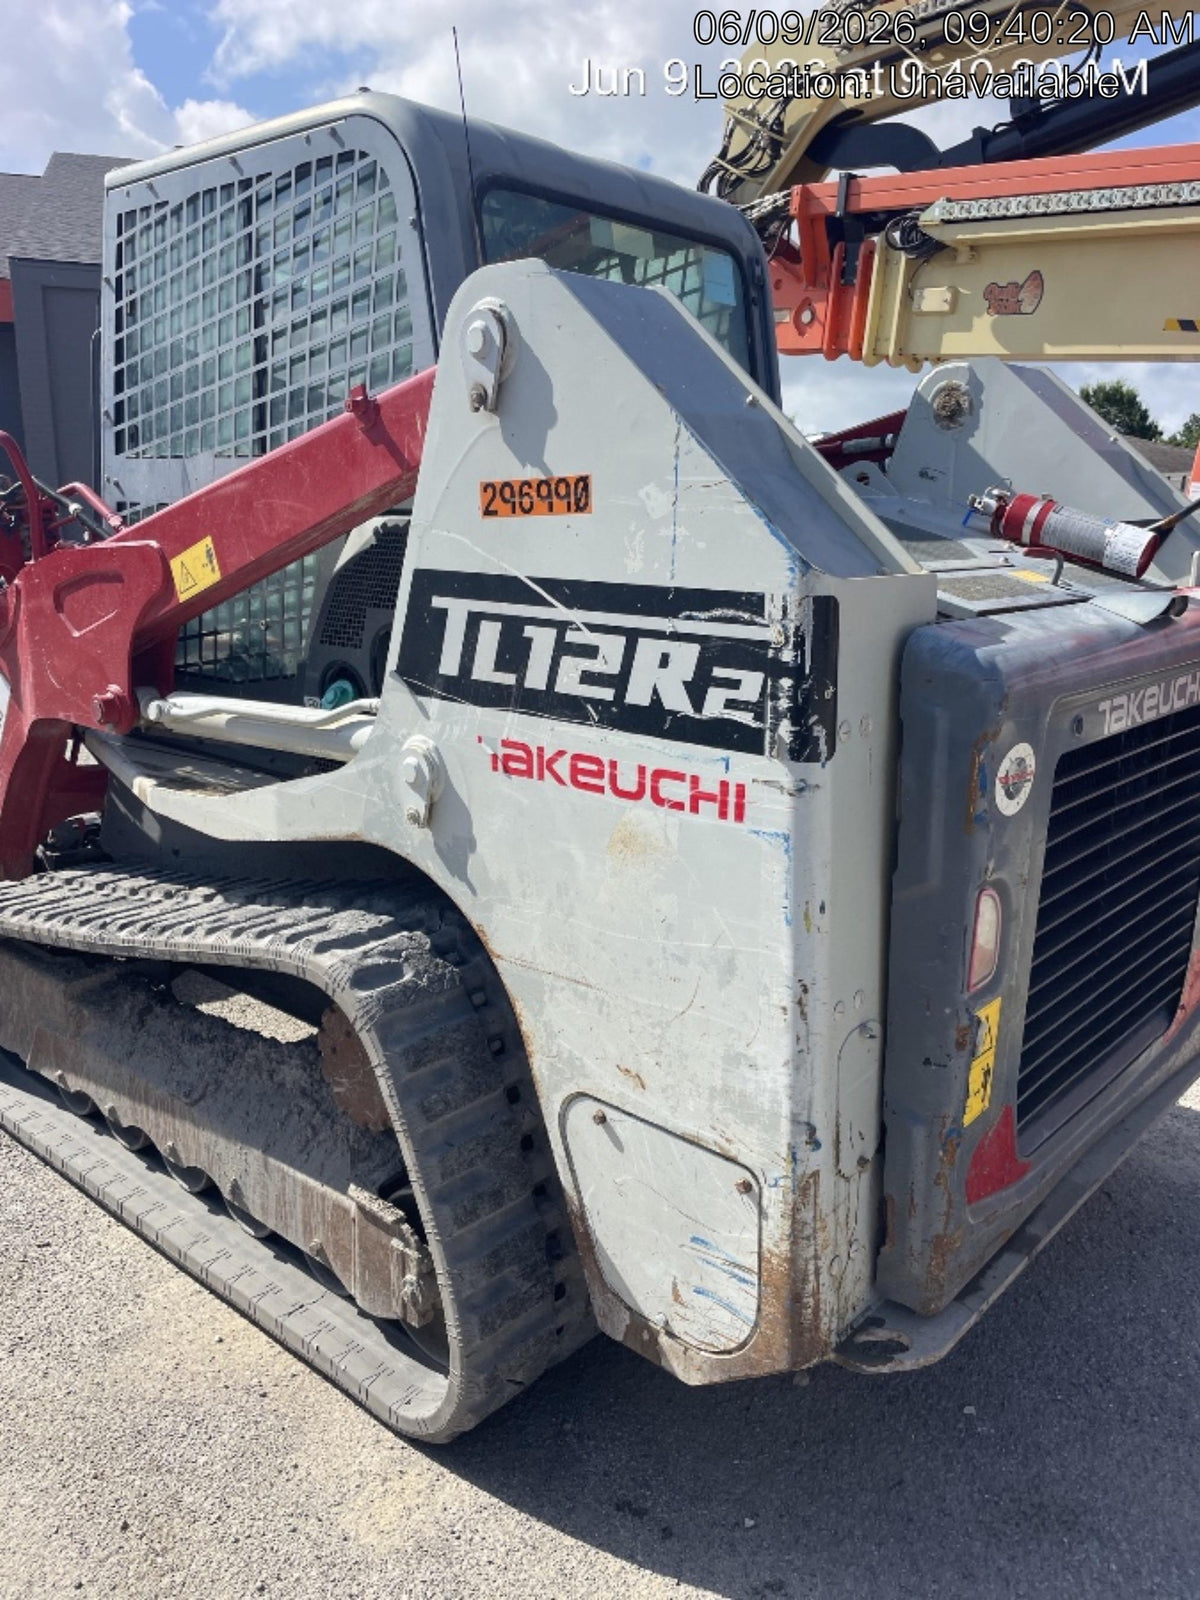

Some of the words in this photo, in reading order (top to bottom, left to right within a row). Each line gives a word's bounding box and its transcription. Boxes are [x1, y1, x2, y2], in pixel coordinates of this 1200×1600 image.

[482, 475, 590, 516] 296990
[431, 595, 775, 723] TL12R2
[1098, 671, 1200, 736] TAKEUCH
